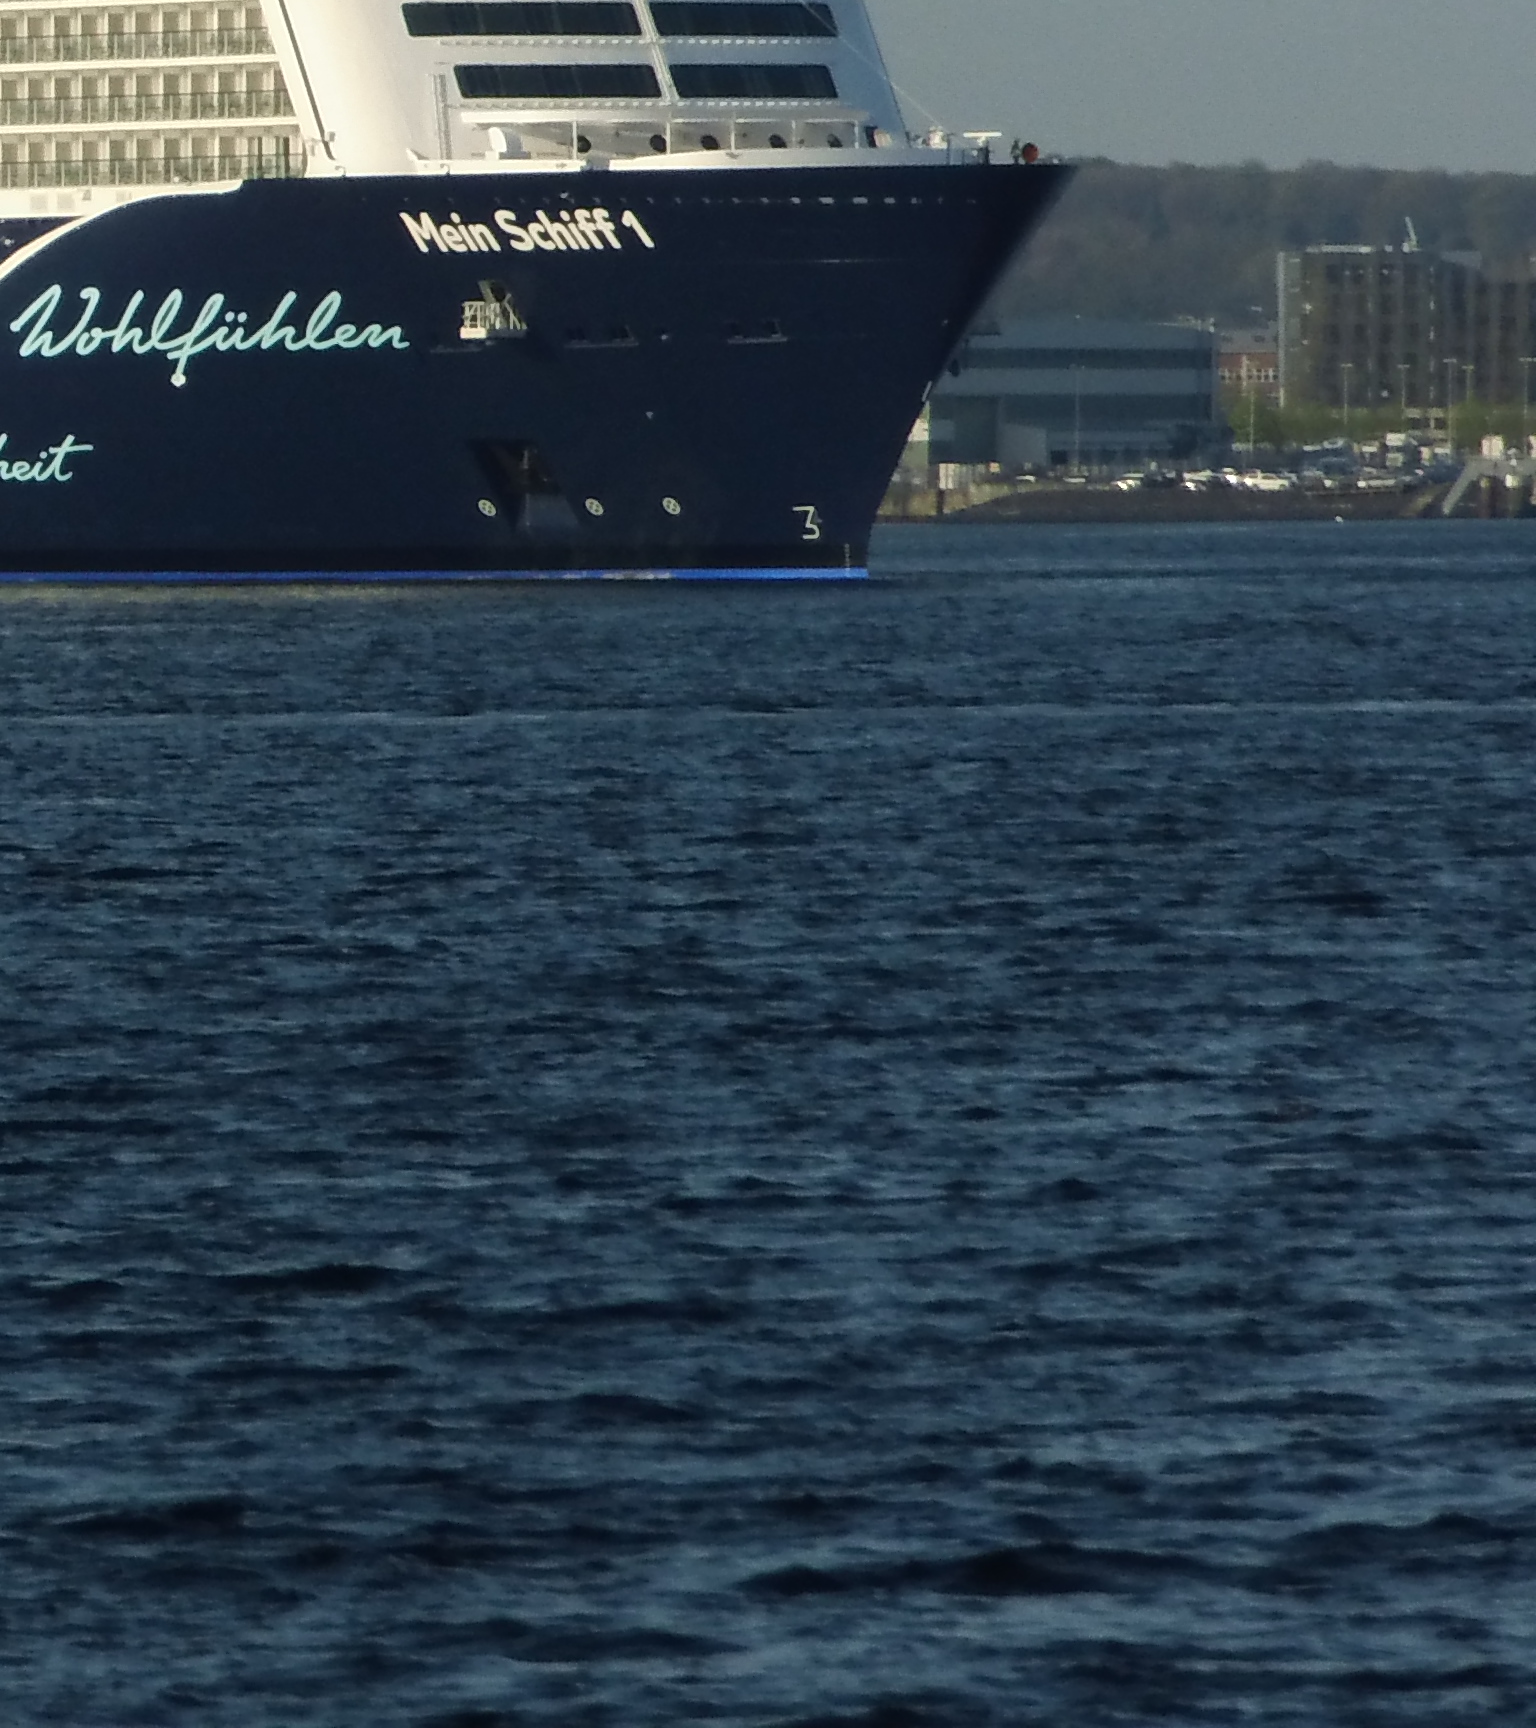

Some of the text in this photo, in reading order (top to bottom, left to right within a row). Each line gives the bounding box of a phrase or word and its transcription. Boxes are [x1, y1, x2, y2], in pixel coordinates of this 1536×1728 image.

[398, 207, 655, 253] Mein Schiff 1
[9, 283, 410, 388] Wohlfühlen
